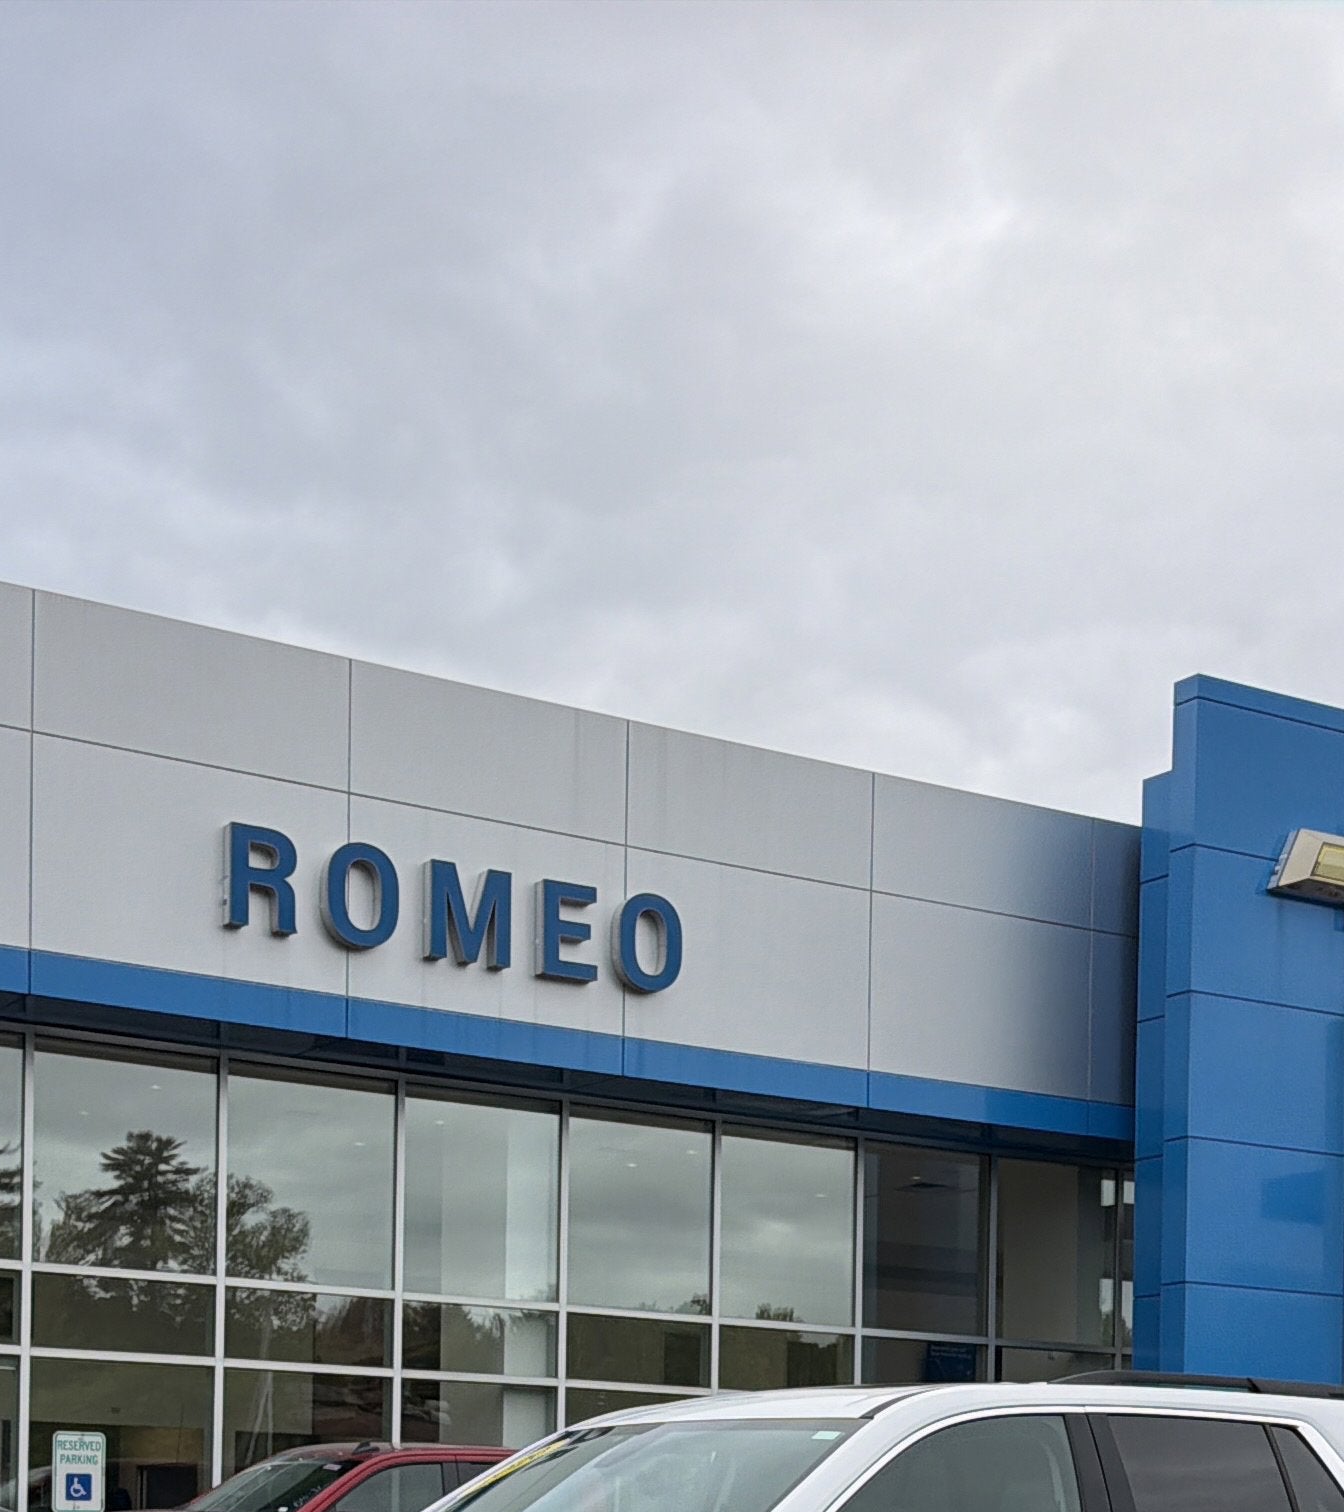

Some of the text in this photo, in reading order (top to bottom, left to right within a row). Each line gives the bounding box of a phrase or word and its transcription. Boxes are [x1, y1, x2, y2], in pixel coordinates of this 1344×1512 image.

[223, 821, 683, 993] ROMEO
[57, 1440, 101, 1451] RESERVED
[60, 1454, 98, 1465] PARKING
